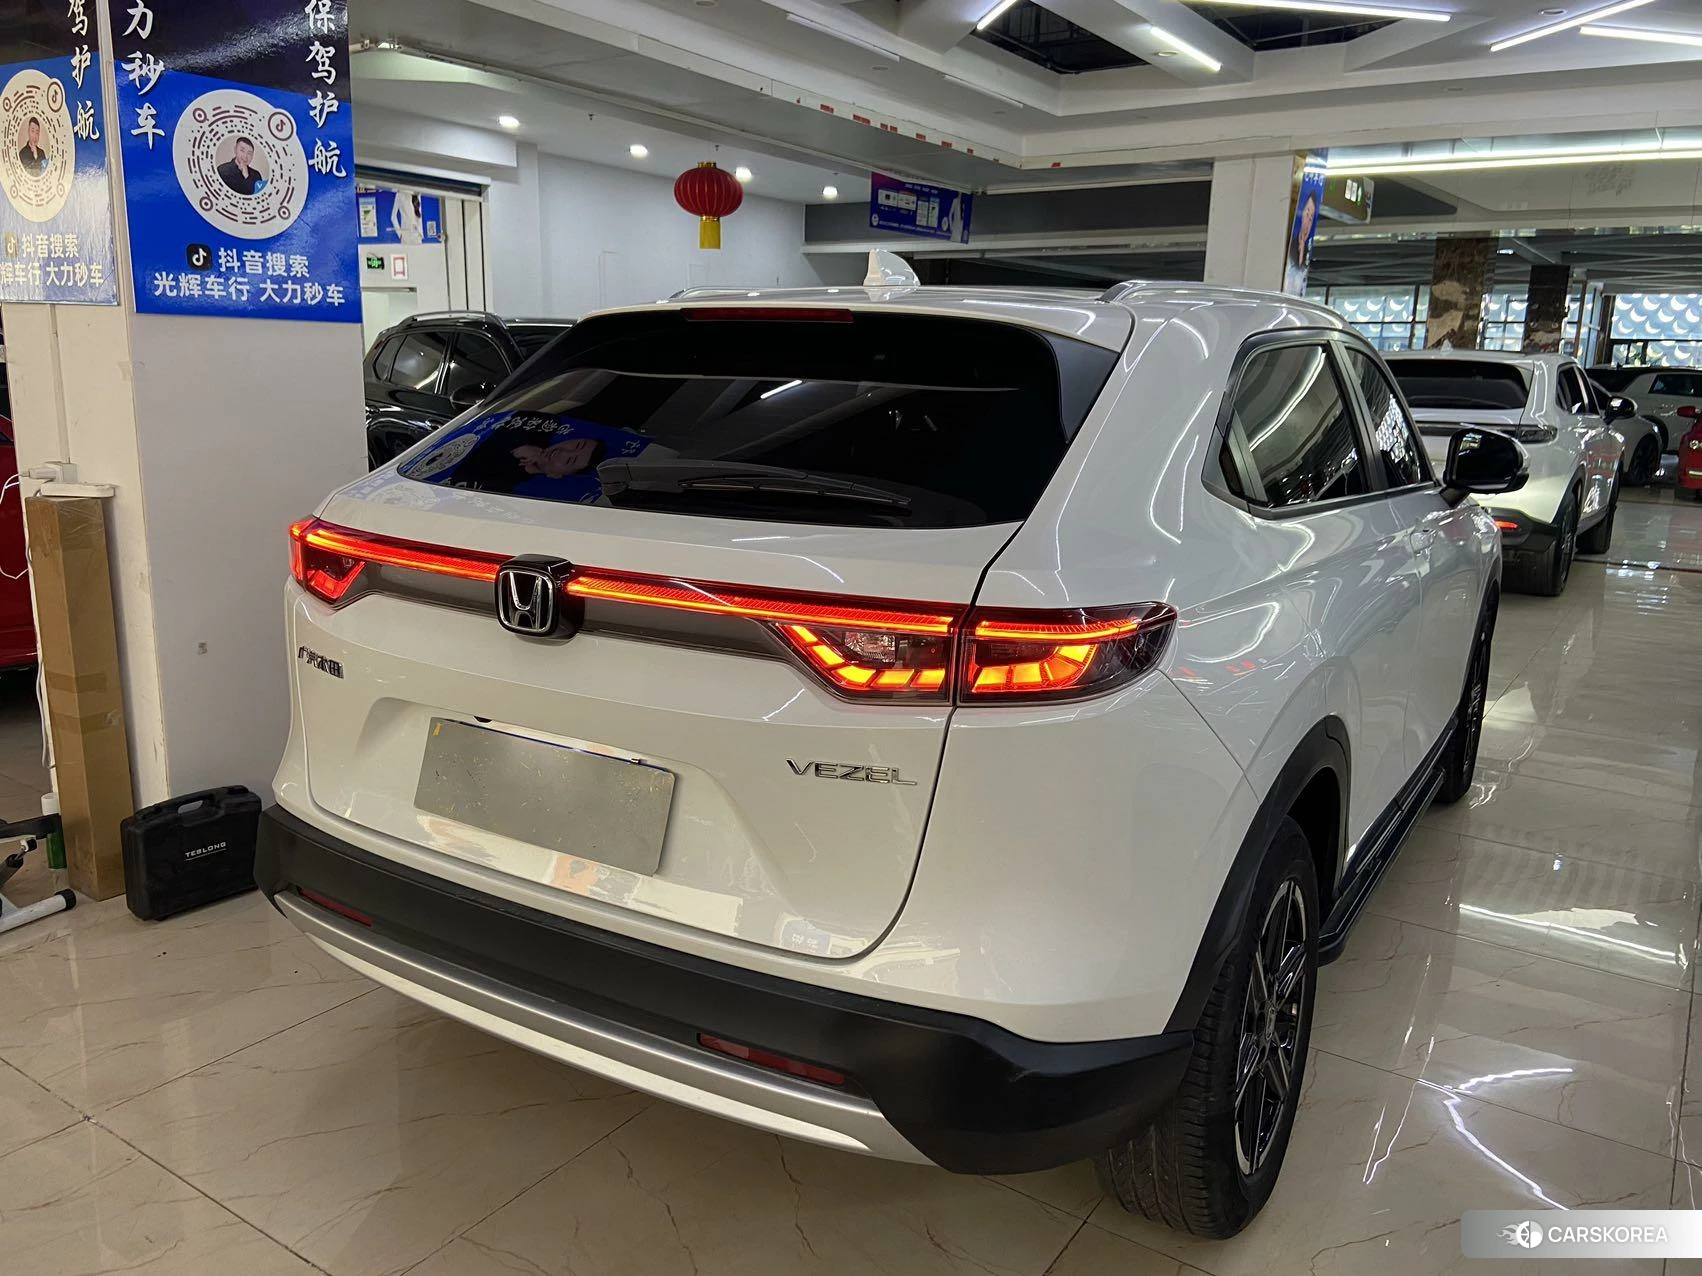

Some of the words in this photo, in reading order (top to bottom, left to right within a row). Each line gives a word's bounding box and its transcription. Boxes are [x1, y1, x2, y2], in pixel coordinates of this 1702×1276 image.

[121, 0, 165, 150] 力秒车
[305, 0, 346, 177] 保驾护航
[22, 233, 79, 258] 抖音搜索
[46, 261, 104, 287] 大力秒车
[218, 247, 310, 278] 抖音搜索
[154, 272, 250, 301] 光辉车行
[259, 279, 346, 307] 大力秒车
[786, 758, 918, 785] VEZEL
